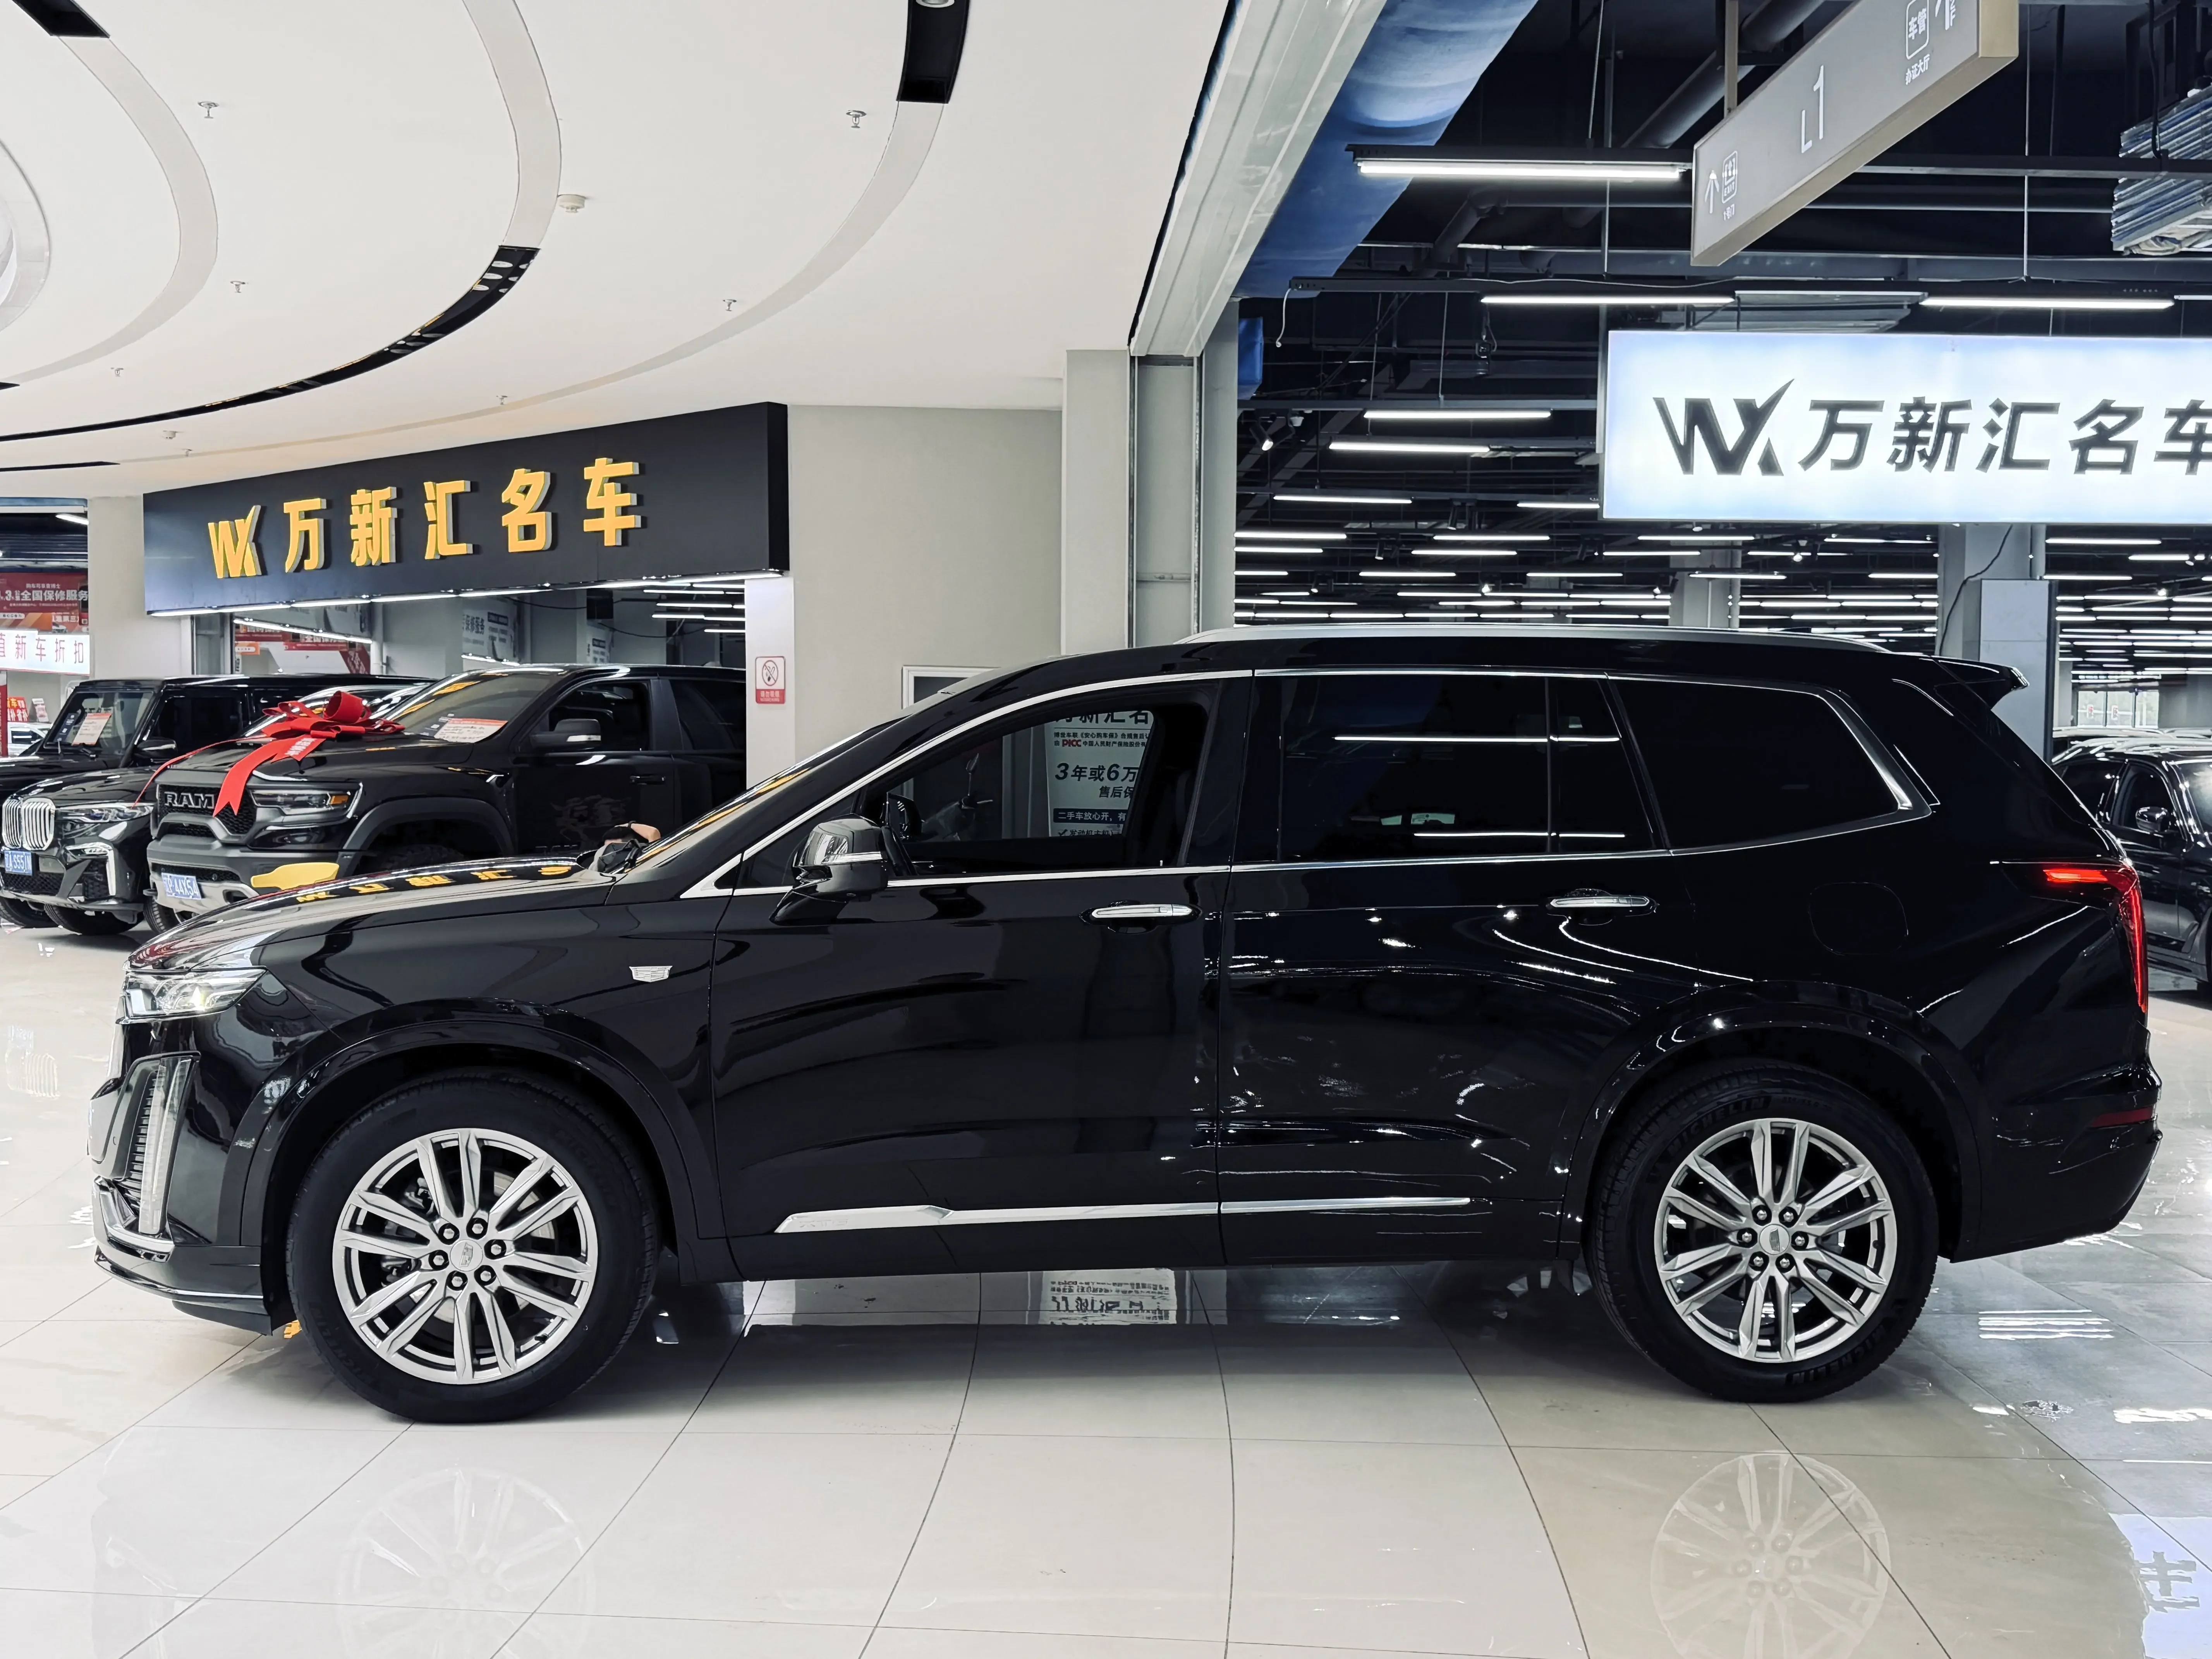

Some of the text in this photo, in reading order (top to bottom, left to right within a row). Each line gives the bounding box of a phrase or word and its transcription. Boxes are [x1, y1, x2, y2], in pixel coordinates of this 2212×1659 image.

[1908, 8, 1927, 40] 车管
[1906, 54, 1930, 85] 办证大厅
[1801, 65, 1824, 153] L1
[1724, 181, 1735, 196] EXIT
[1798, 396, 2212, 476] 万新汇名车
[283, 457, 641, 573] 万新汇名车
[1055, 763, 1139, 782] 3年或6万
[164, 792, 214, 809] RAM
[1099, 786, 1134, 798] 售后保
[1667, 1097, 1765, 1156] MICHELIN
